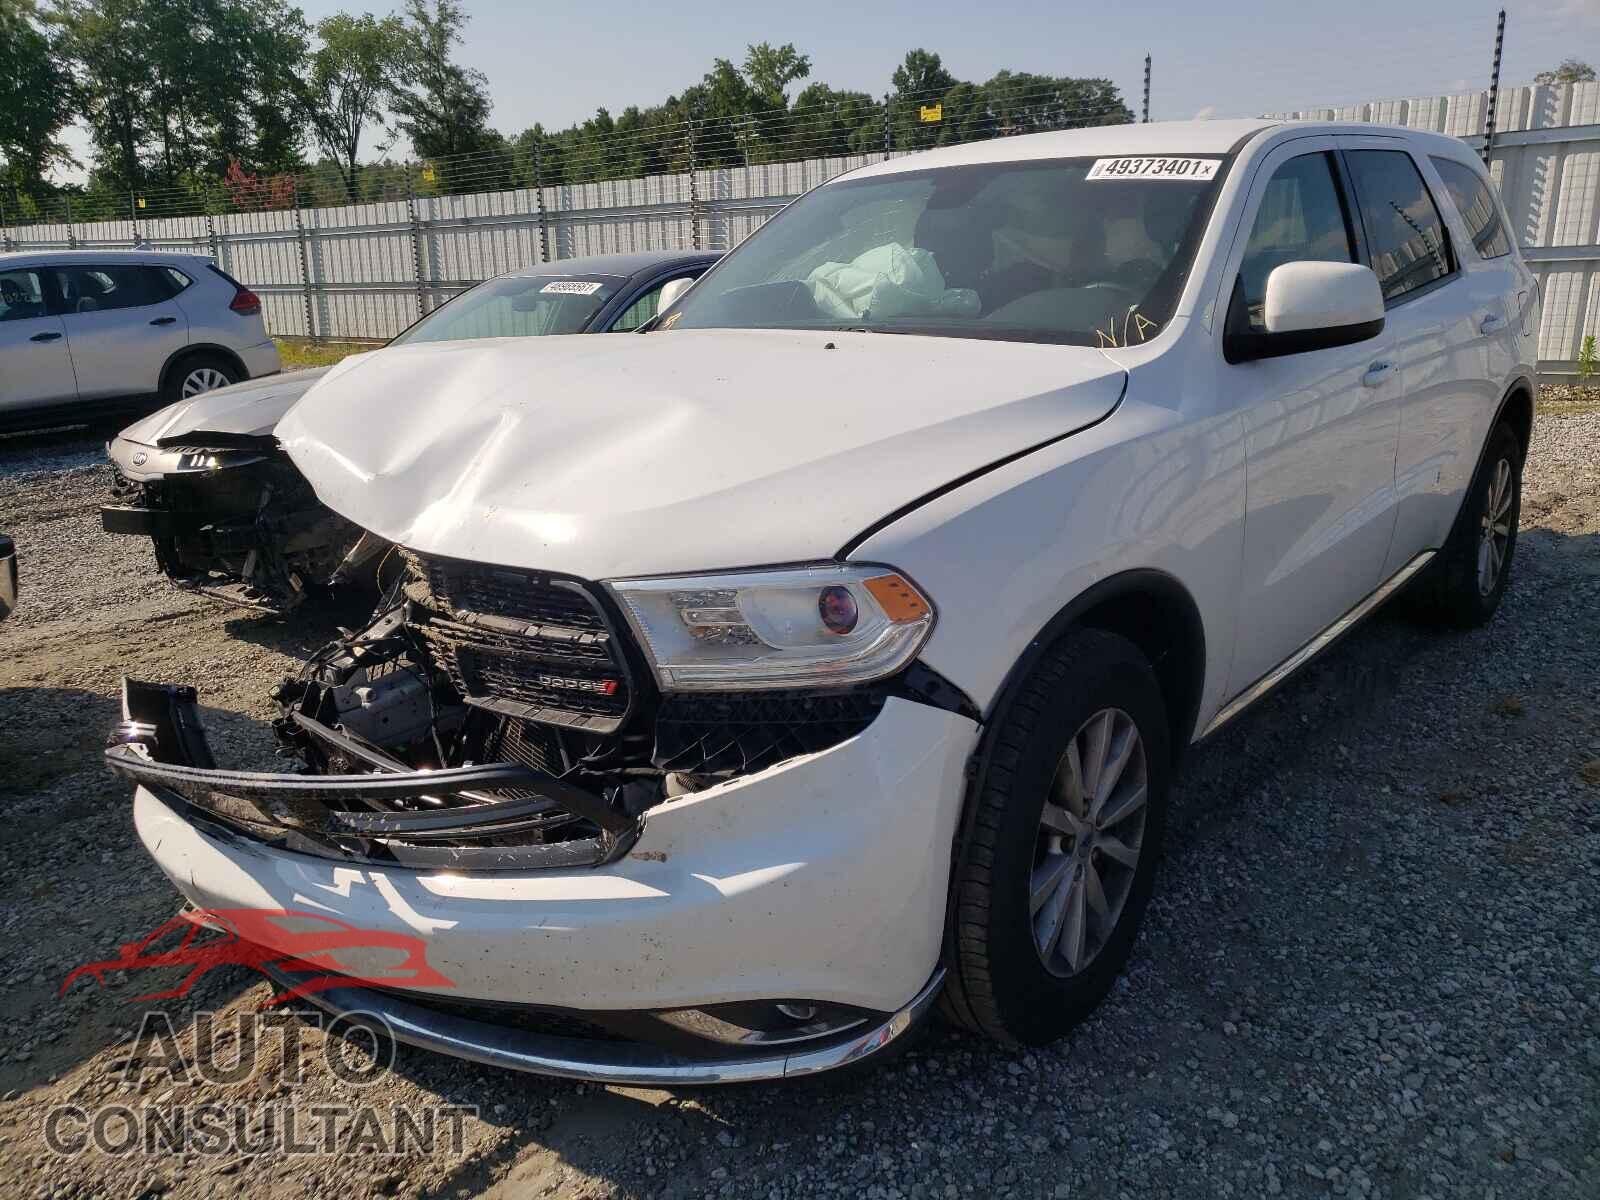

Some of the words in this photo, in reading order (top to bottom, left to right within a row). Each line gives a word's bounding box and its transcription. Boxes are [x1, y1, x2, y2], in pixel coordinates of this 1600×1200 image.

[1105, 159, 1202, 175] 49373401
[1096, 304, 1158, 347] N/A
[540, 676, 607, 695] DODGE
